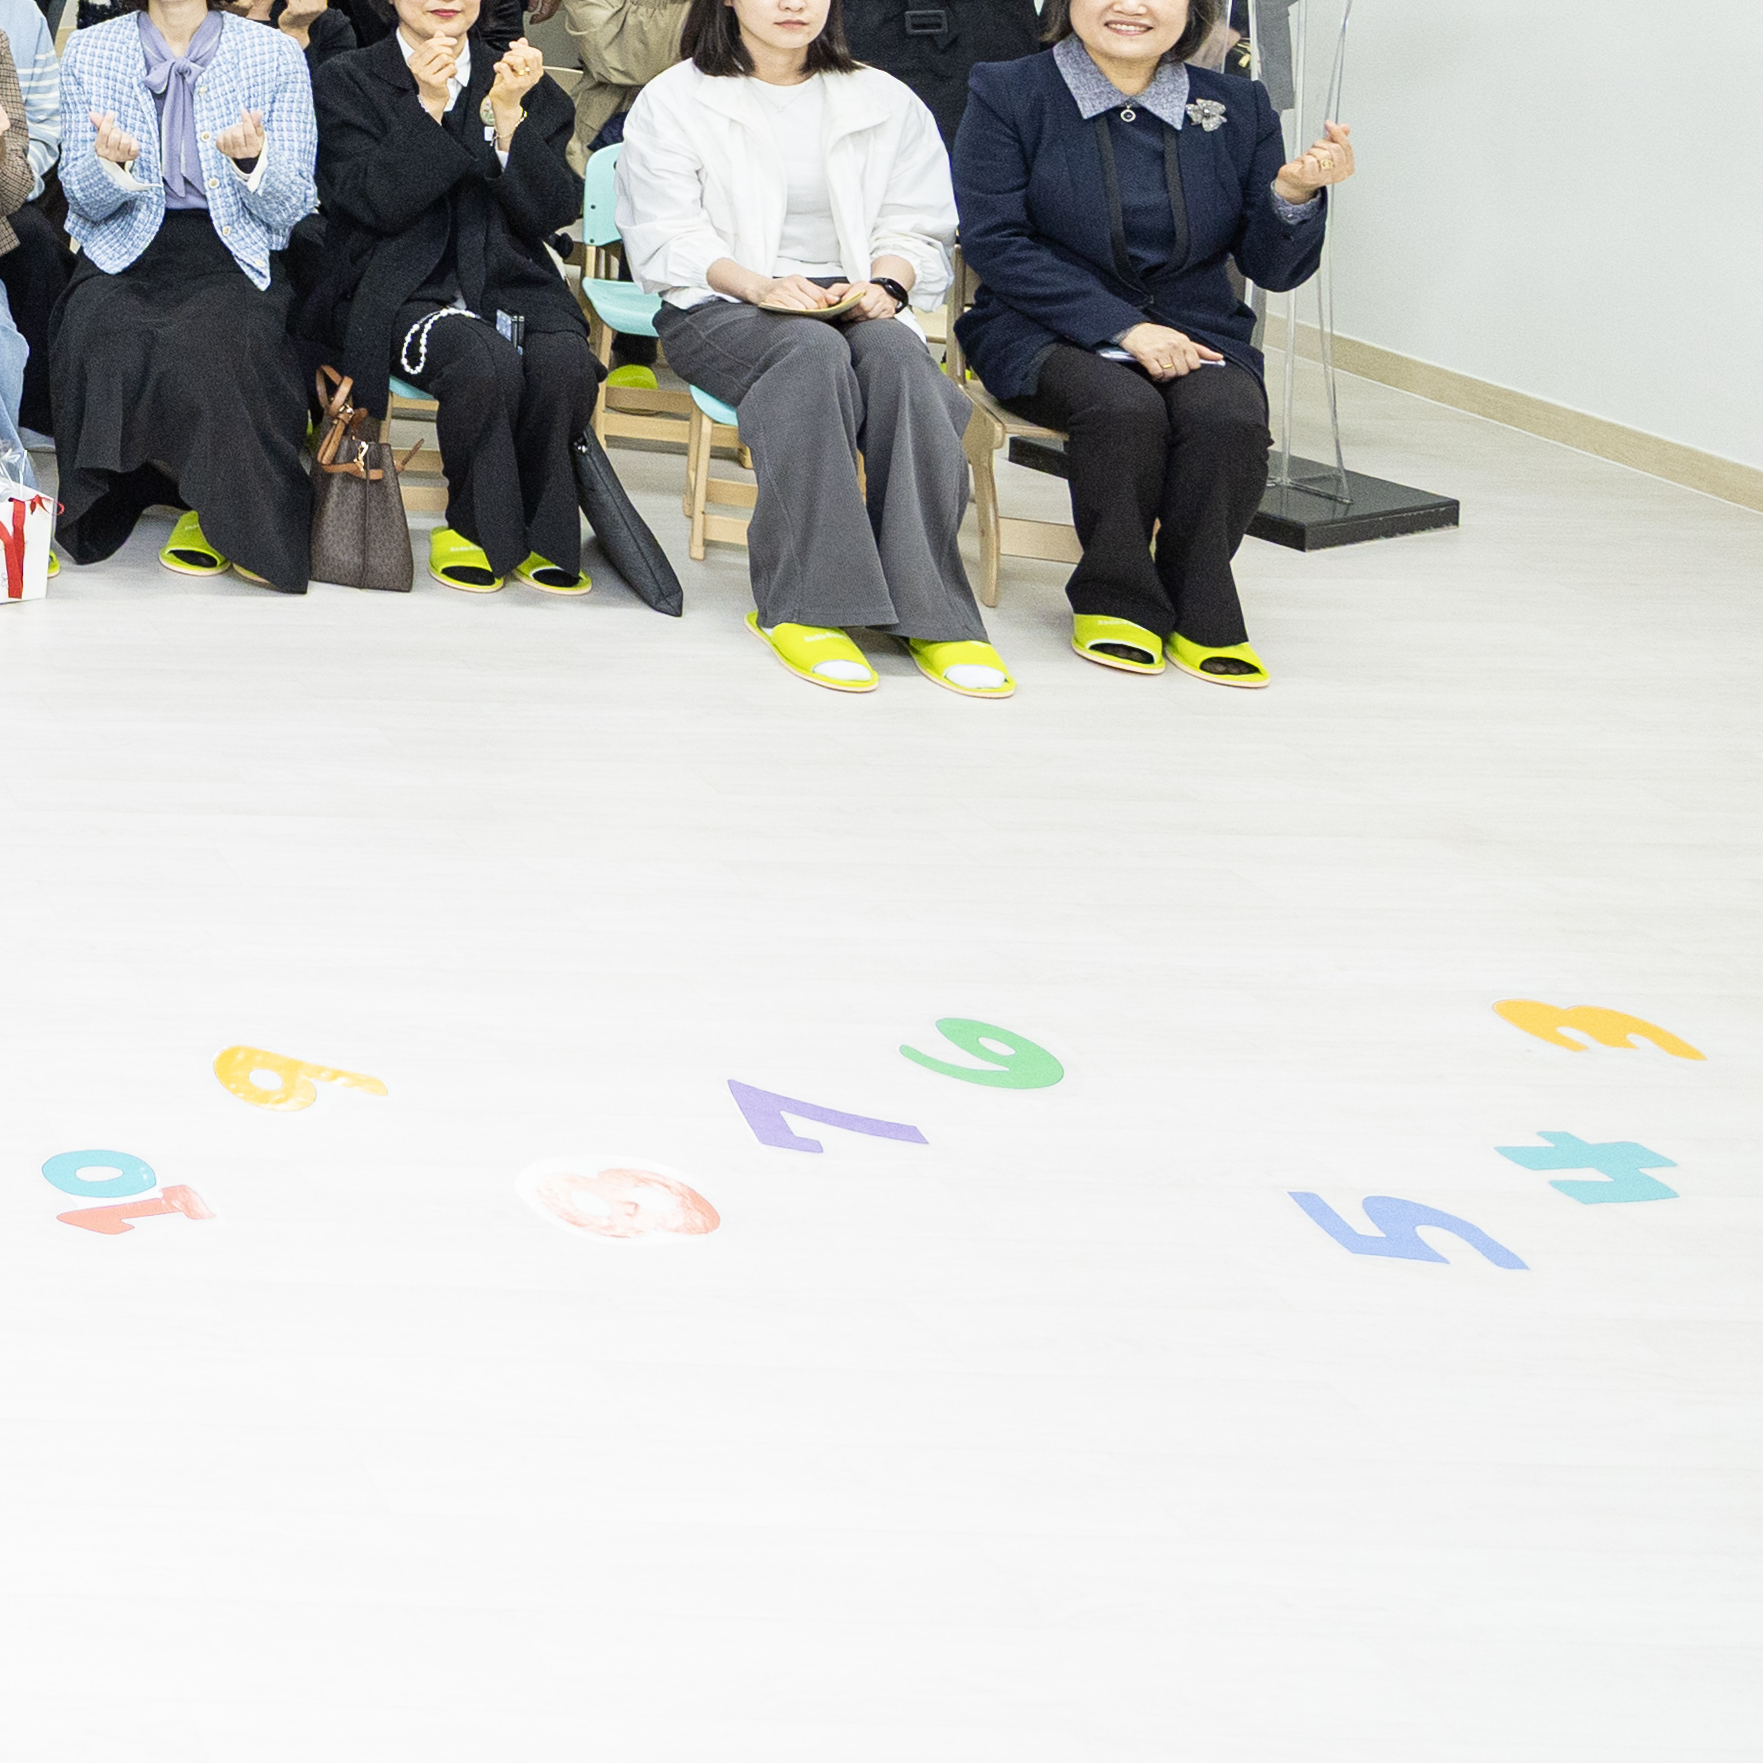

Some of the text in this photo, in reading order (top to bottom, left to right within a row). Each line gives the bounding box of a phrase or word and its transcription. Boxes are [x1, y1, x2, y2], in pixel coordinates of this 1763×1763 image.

[1492, 998, 1708, 1061] 3
[726, 1078, 930, 1154] 7
[1492, 1131, 1681, 1205] 4
[1286, 1190, 1531, 1271] 5
